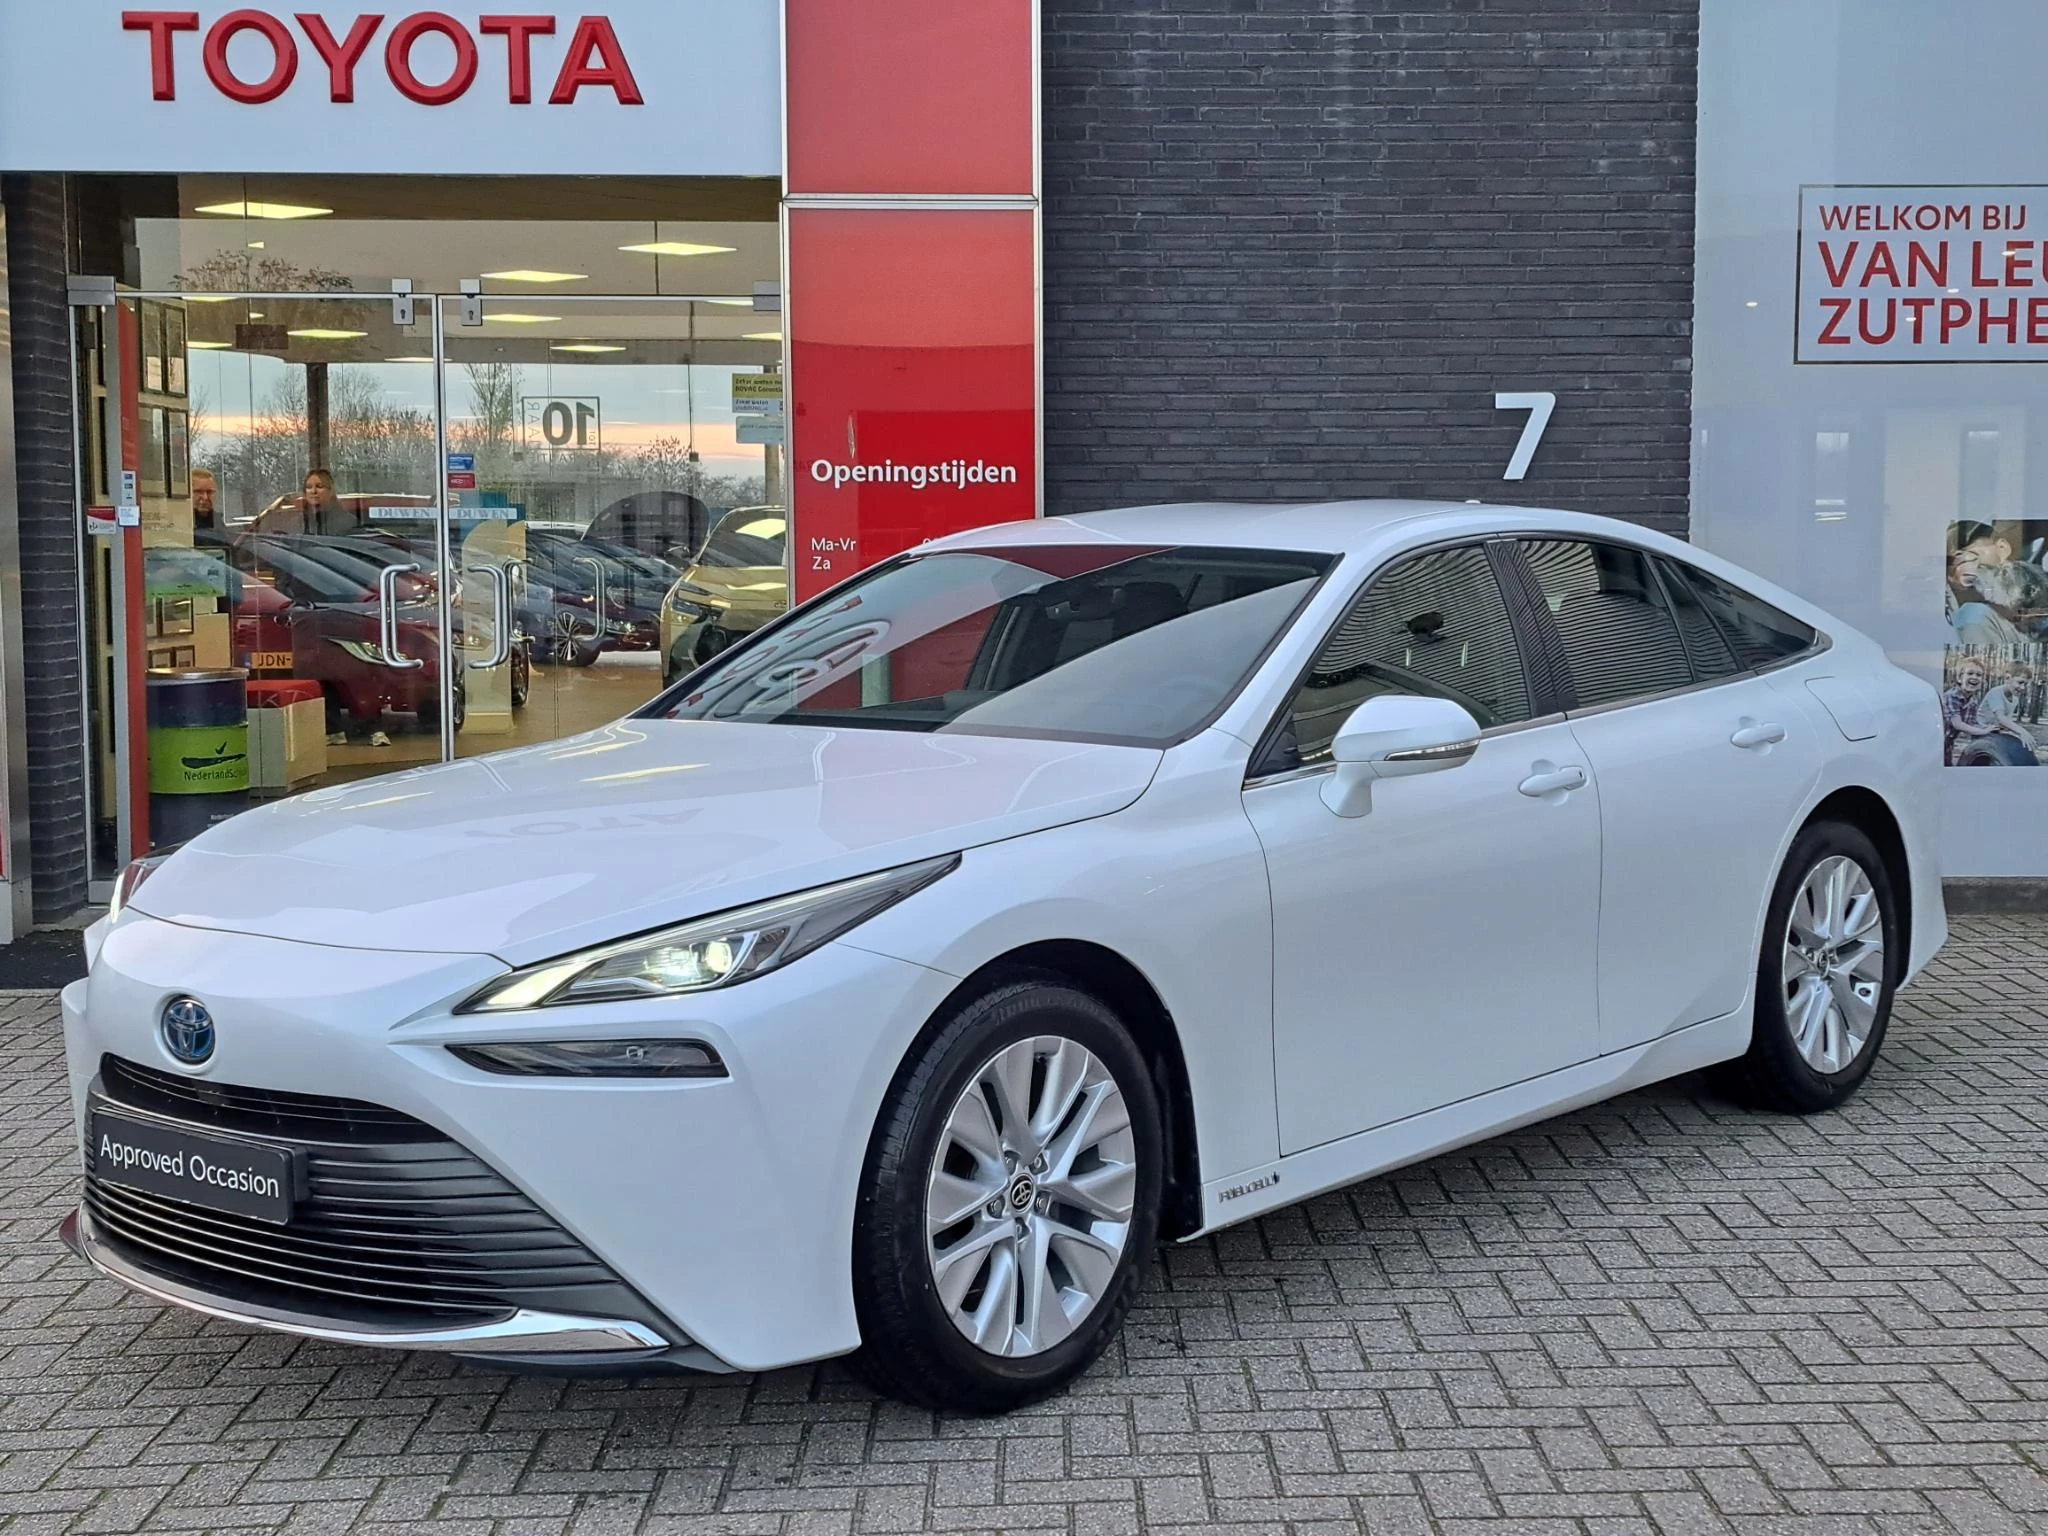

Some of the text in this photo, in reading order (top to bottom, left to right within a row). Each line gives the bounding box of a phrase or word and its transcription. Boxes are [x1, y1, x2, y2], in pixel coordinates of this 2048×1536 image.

[121, 8, 645, 106] TOYOTA
[1819, 205, 2026, 231] WELKOM BIJ
[1818, 240, 2048, 288] VAN LE
[1495, 392, 1556, 480] 7
[811, 459, 1017, 489] Openingstijden
[377, 508, 431, 518] DUWEN
[456, 508, 509, 519] DUWEN
[811, 537, 857, 551] Ma-Vr
[812, 556, 831, 570] Za
[100, 1133, 280, 1199] Approved Occasion
